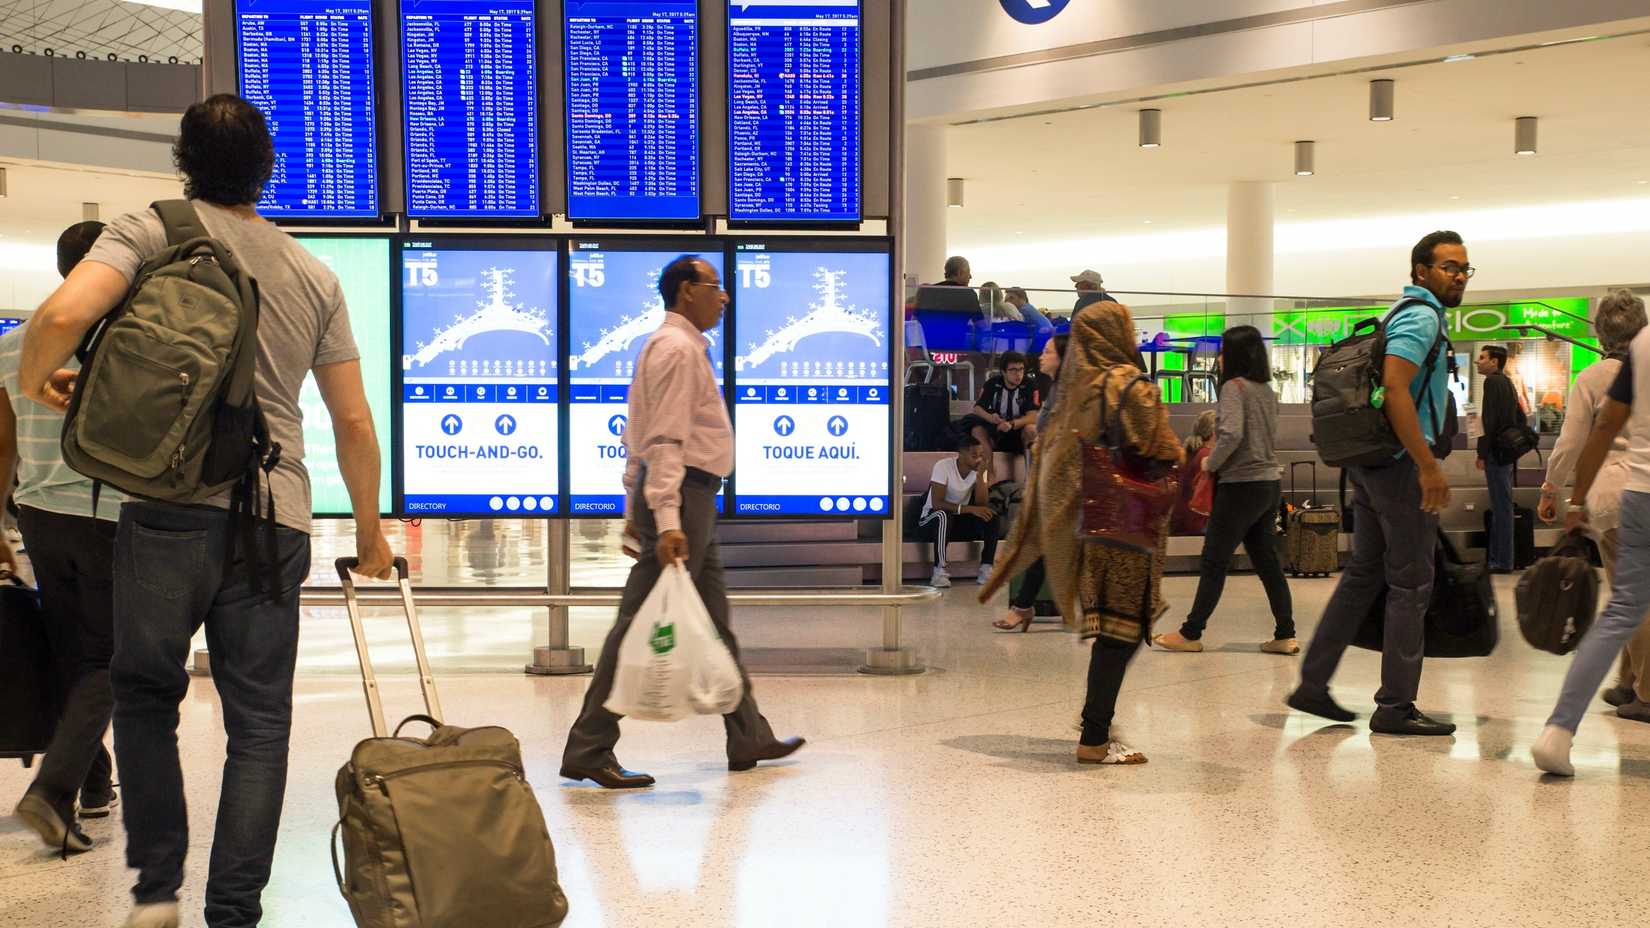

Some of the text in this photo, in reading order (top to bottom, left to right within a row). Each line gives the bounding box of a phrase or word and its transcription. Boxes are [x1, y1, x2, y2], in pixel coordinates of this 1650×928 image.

[405, 262, 438, 286] T5
[738, 263, 770, 288] T5
[416, 445, 543, 459] TOUCH-AND-GO.
[764, 441, 860, 460] TOQUE AQUÍ.
